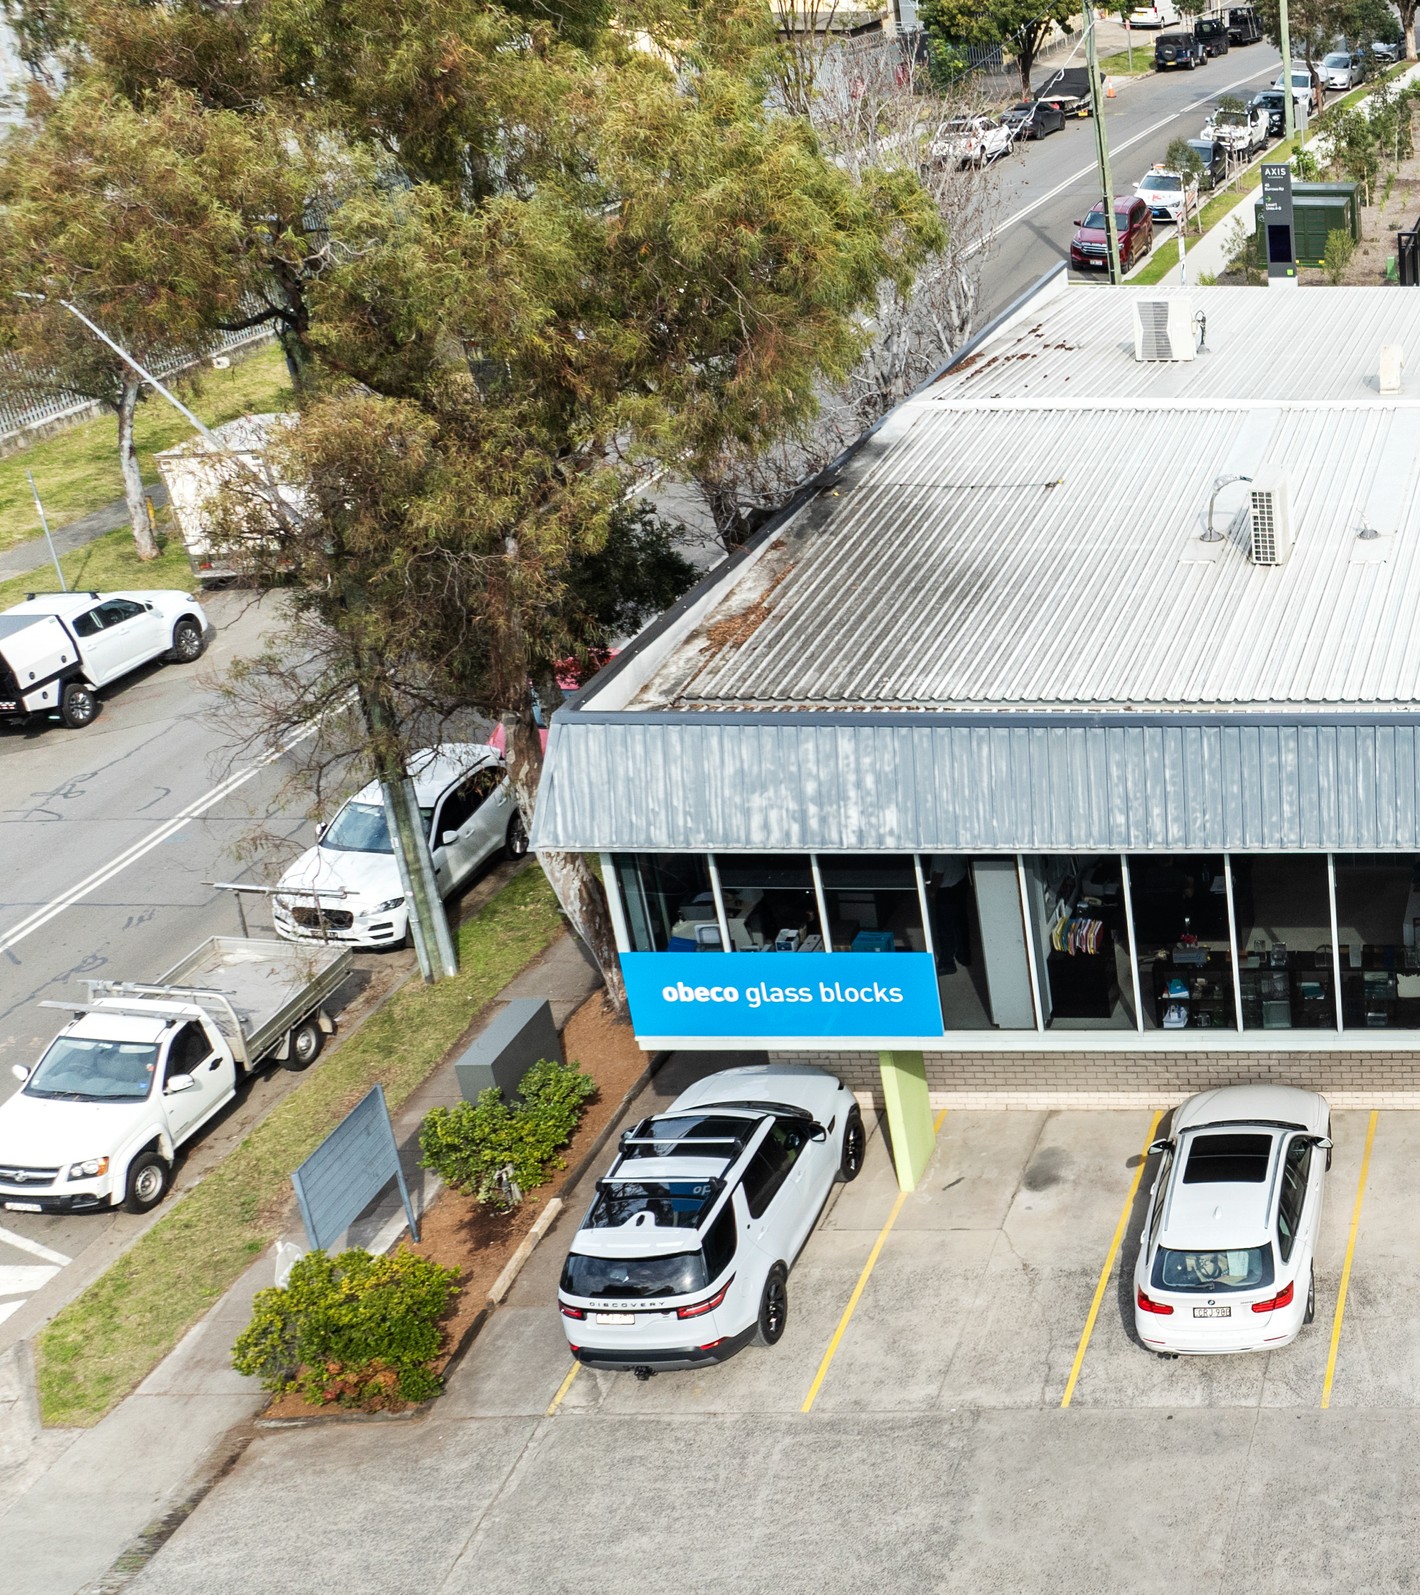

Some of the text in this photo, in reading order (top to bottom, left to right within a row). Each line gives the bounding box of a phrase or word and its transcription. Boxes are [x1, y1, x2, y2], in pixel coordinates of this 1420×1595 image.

[1265, 168, 1286, 176] AXIS
[662, 981, 904, 1008] obeco glass blocks
